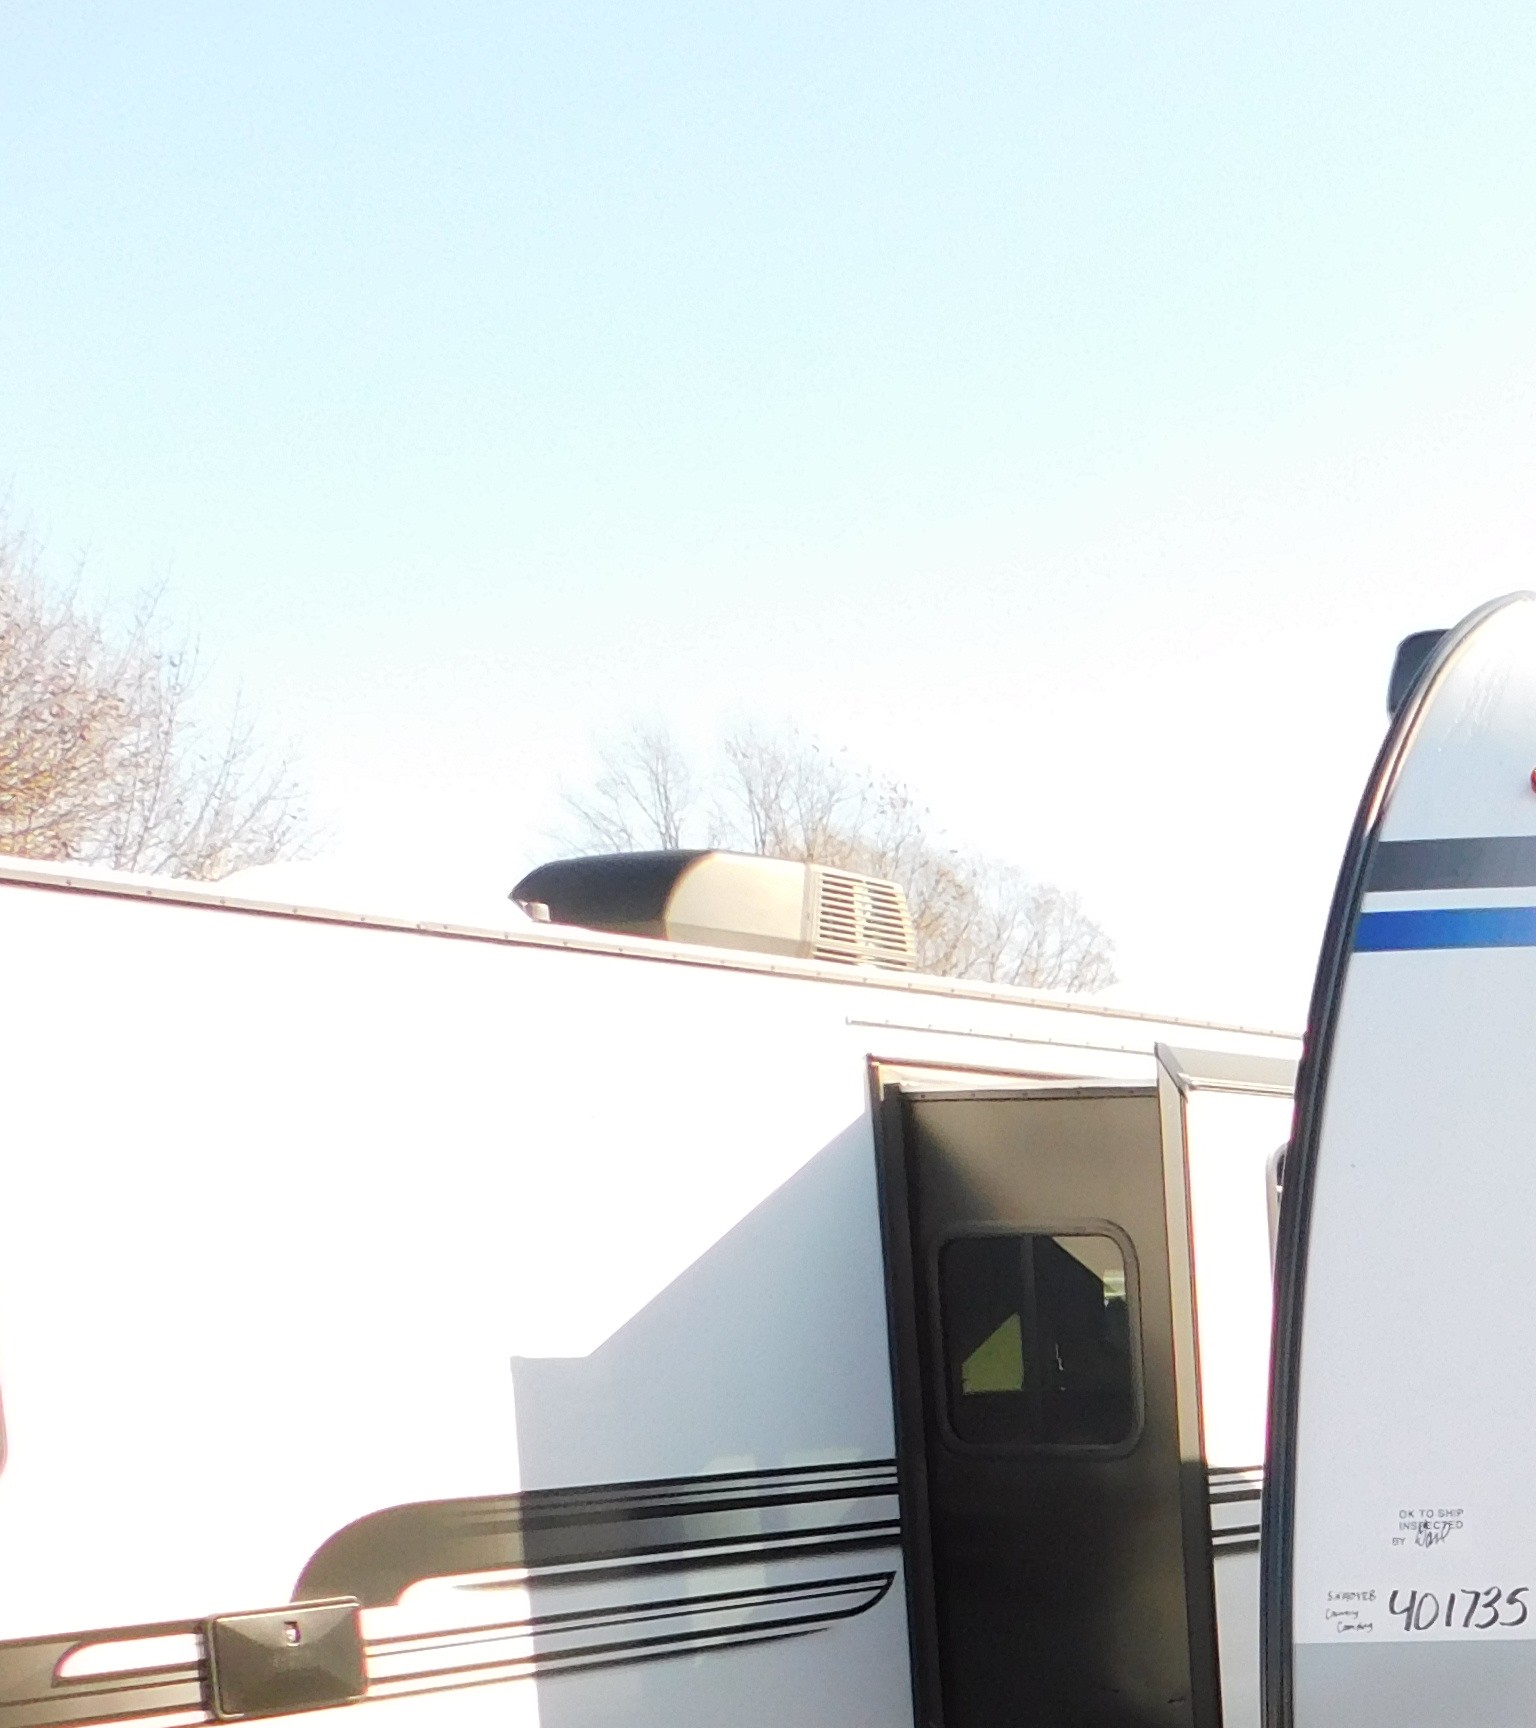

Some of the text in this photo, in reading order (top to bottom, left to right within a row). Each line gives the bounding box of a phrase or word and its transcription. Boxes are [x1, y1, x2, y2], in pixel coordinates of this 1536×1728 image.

[1399, 1508, 1464, 1519] OK TO SHIP
[1399, 1520, 1464, 1530] INSPECTED
[1388, 1585, 1530, 1632] 401735
